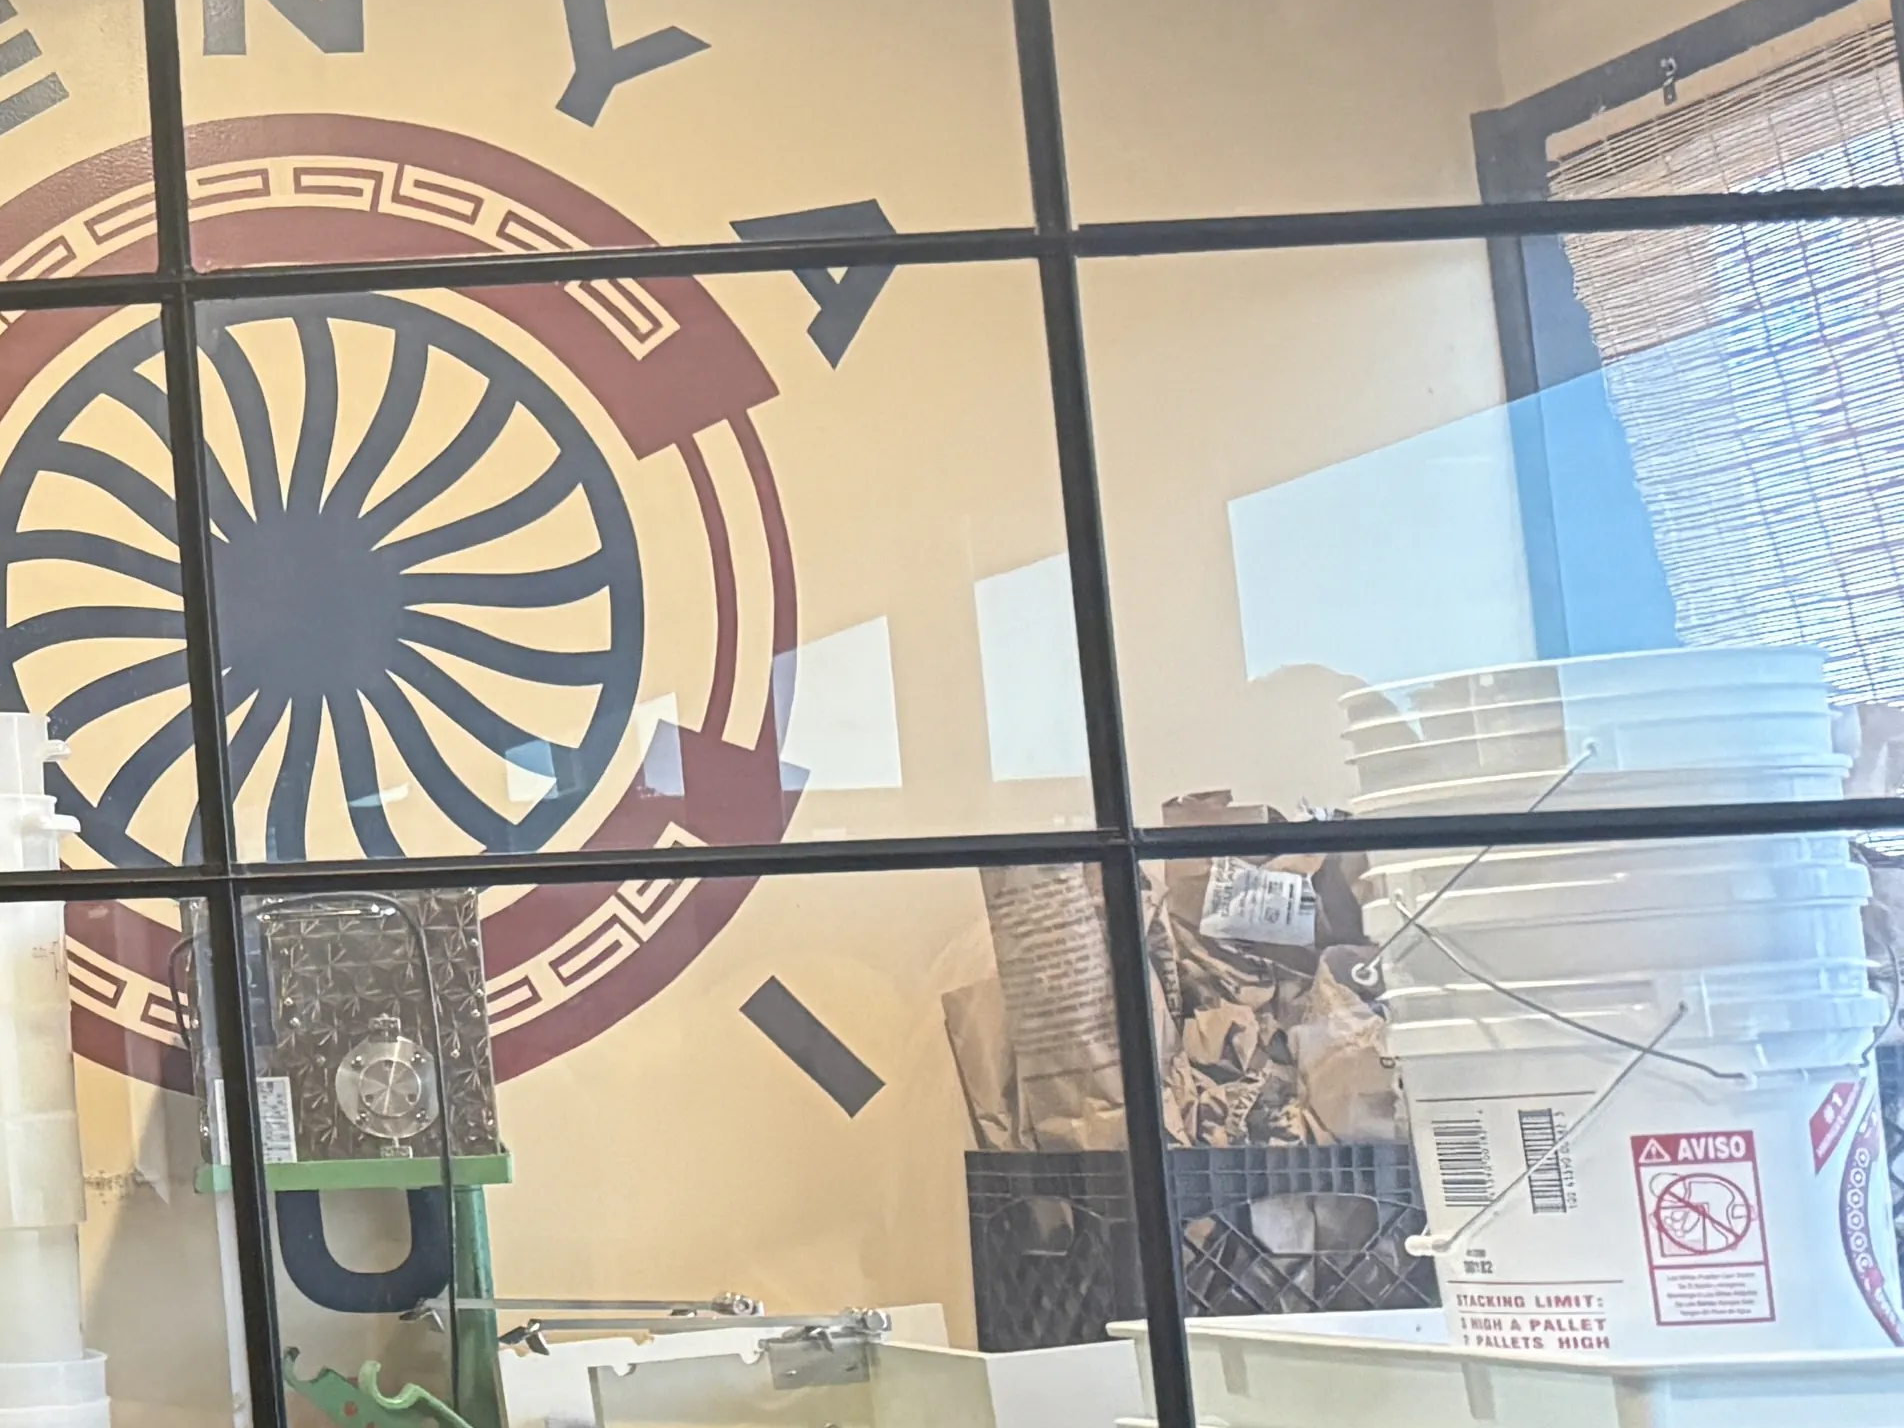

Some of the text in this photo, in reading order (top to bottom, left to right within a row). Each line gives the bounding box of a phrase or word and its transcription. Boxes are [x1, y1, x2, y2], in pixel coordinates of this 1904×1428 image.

[1677, 1134, 1747, 1161] AVISO
[1456, 1294, 1605, 1309] STACKING LIMIT:
[1470, 1317, 1503, 1331] HIGH
[1510, 1318, 1522, 1332] A
[1528, 1318, 1607, 1332] PALLET
[1476, 1335, 1545, 1350] PALLETS
[1558, 1336, 1611, 1350] HIGH
